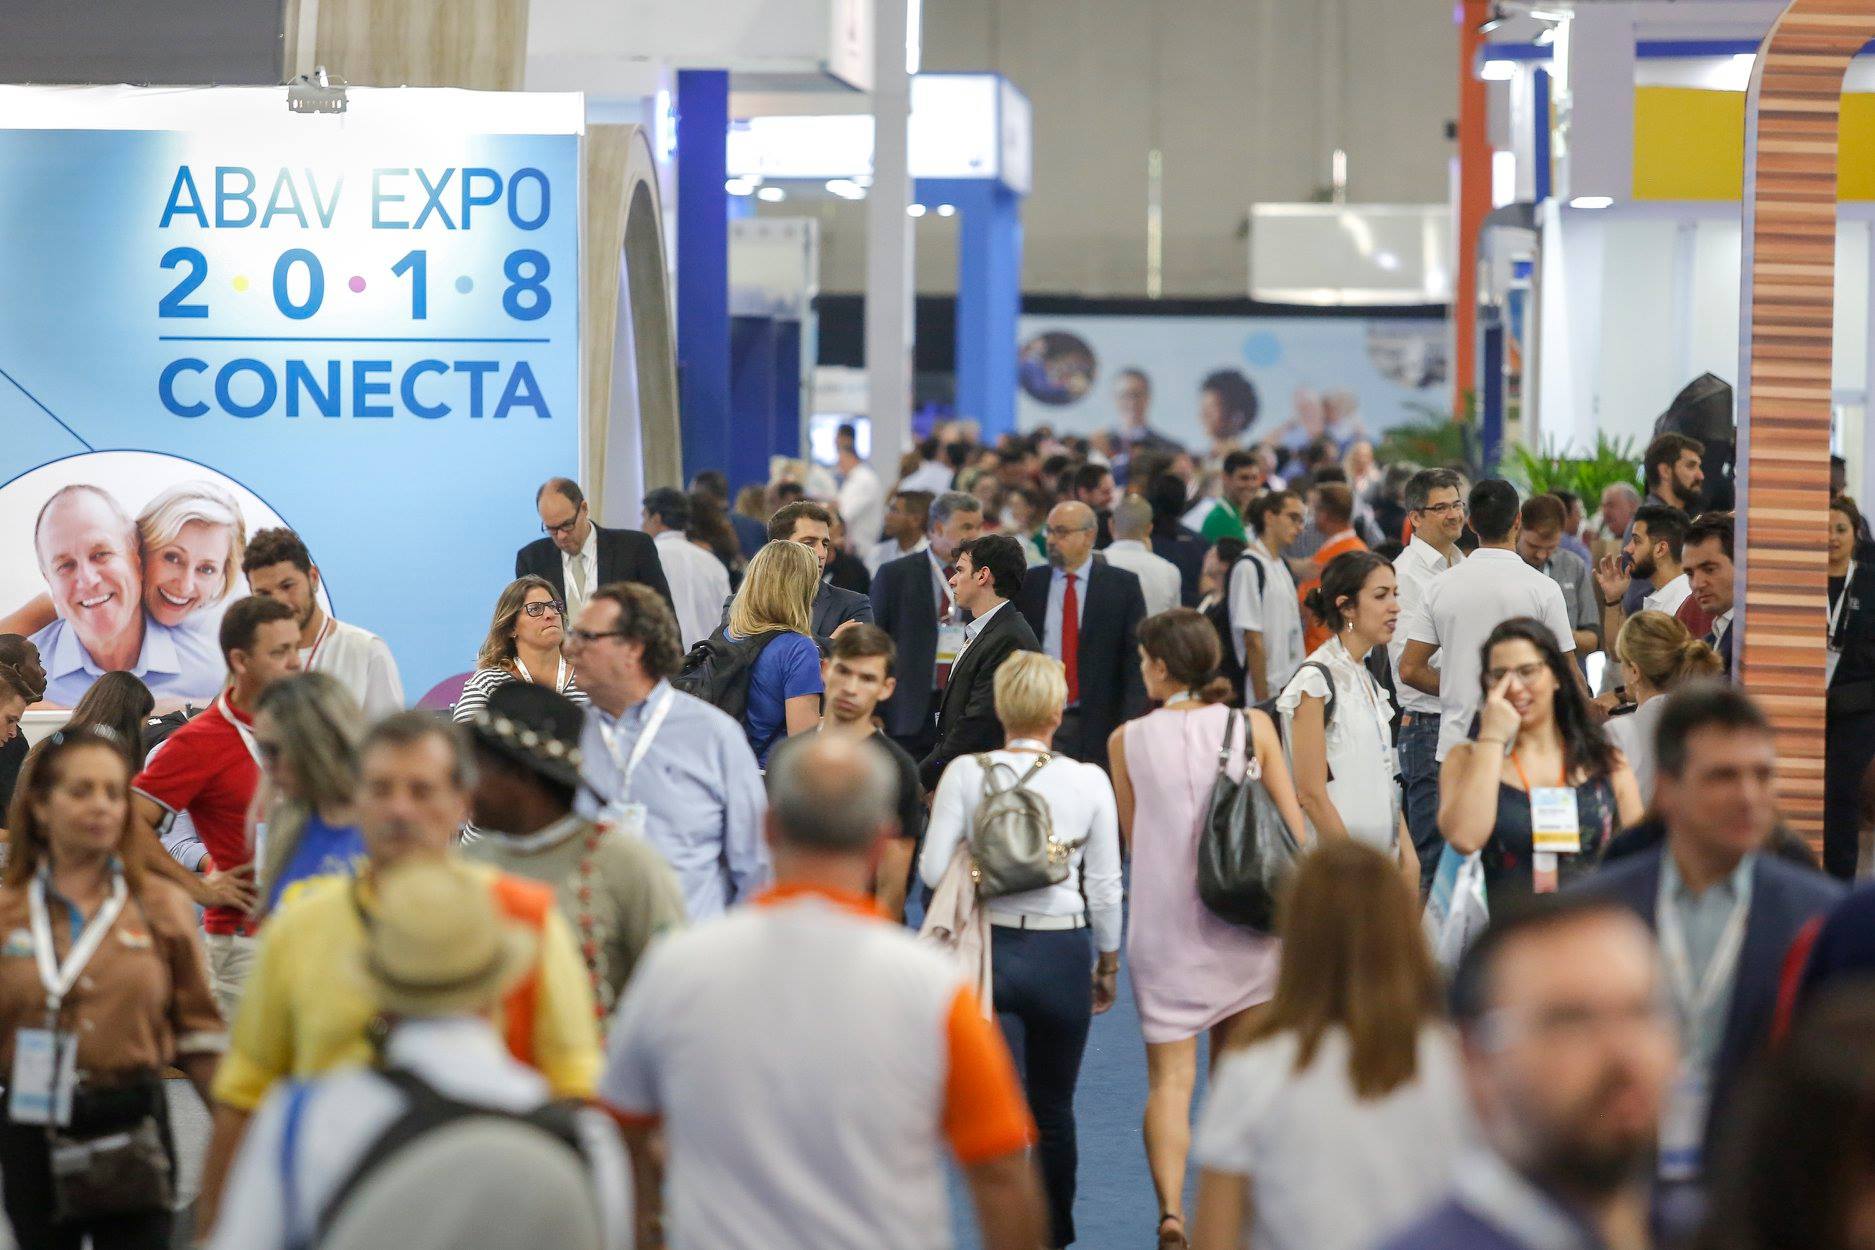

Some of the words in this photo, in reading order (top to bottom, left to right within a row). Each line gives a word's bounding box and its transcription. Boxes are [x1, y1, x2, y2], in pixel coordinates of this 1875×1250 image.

[158, 165, 345, 230] ABAV
[371, 167, 551, 231] EXPO
[158, 357, 552, 419] CONECTA
